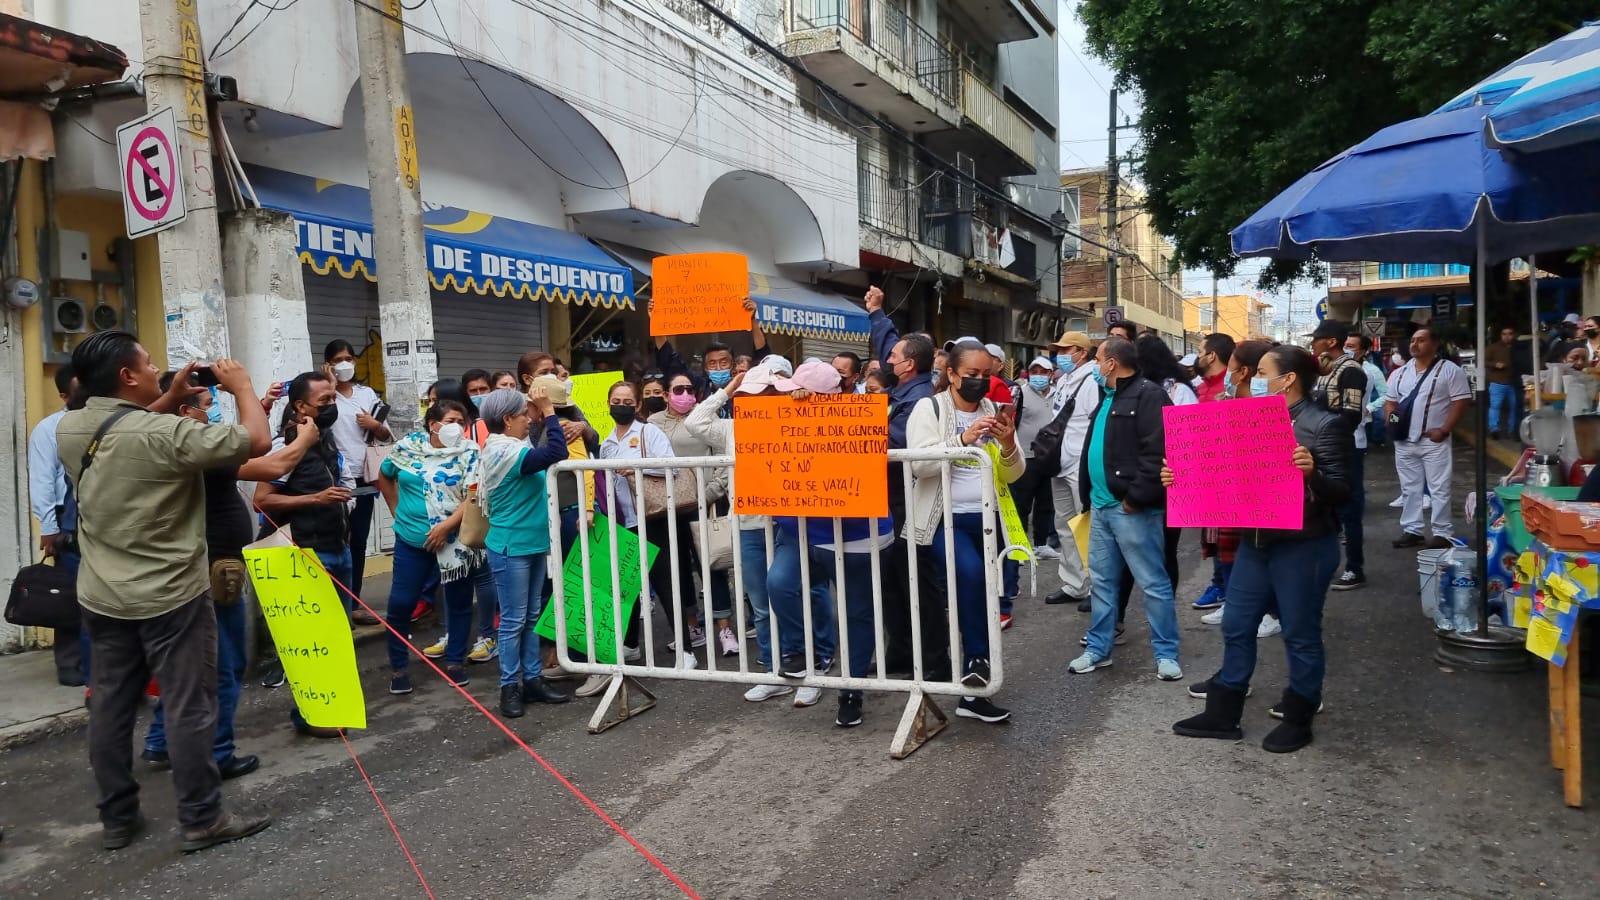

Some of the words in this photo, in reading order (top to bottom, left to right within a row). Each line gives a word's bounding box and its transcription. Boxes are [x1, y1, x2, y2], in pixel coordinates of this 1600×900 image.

[140, 144, 165, 203] E
[294, 220, 376, 259] TIEN
[433, 244, 473, 273] DE
[481, 253, 625, 294] DESCUENTO
[762, 304, 780, 321] DE
[782, 307, 846, 330] DESCUENTO
[734, 405, 773, 420] PLANTEL
[777, 407, 792, 419] 13
[780, 425, 811, 438] PIDE
[847, 425, 888, 438] GENERAL
[766, 460, 773, 474] Y
[780, 461, 791, 473] SI
[782, 479, 801, 492] QUE
[805, 480, 817, 491] SE
[737, 496, 745, 509] 8
[747, 496, 778, 508] MESES
[780, 496, 791, 508] DE
[289, 551, 319, 579] 16
